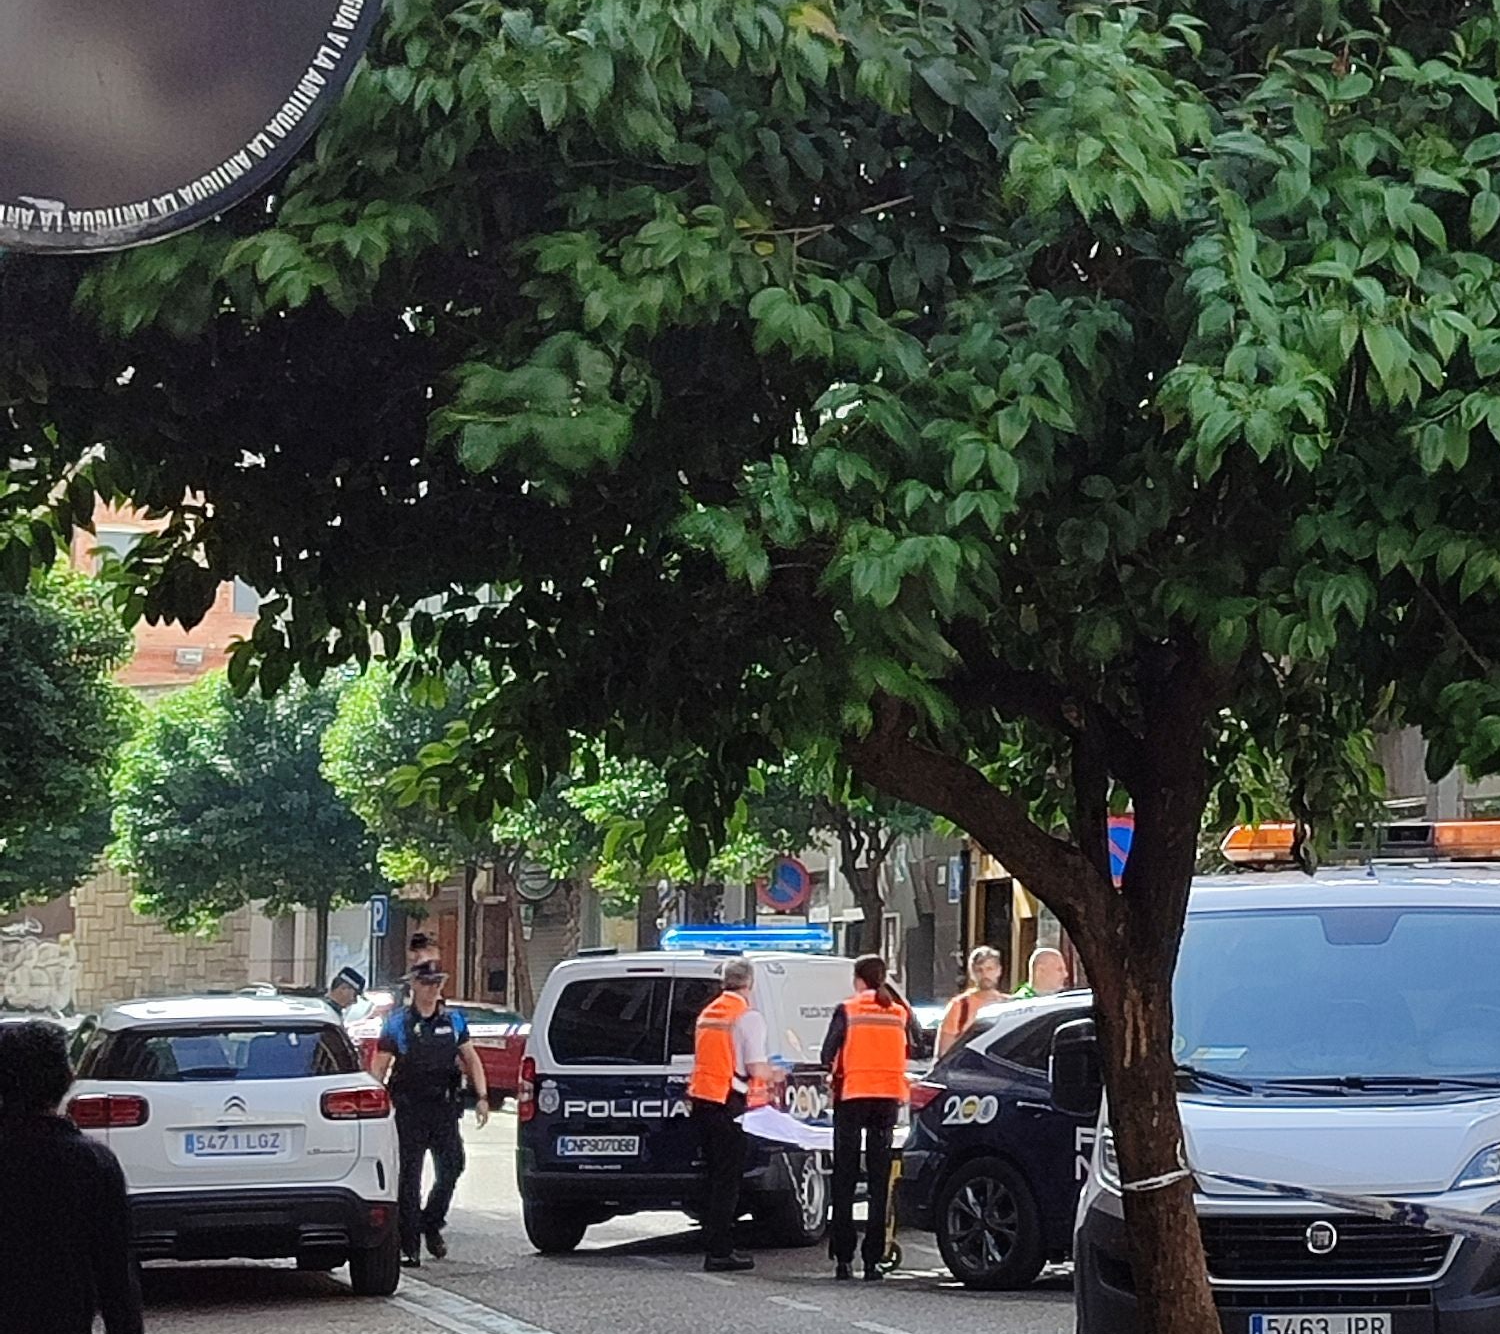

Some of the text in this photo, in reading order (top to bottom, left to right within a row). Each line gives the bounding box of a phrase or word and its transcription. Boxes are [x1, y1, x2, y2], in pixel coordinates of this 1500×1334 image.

[313, 45, 341, 70] LA
[266, 67, 326, 139] ANTIGUA
[246, 132, 275, 158] LA
[178, 150, 253, 205] ANTIGUA
[152, 193, 180, 217] LA
[373, 904, 384, 935] P
[564, 1100, 691, 1118] POLICIA
[942, 1095, 999, 1125] 200
[196, 1133, 281, 1151] 5471 LGZ
